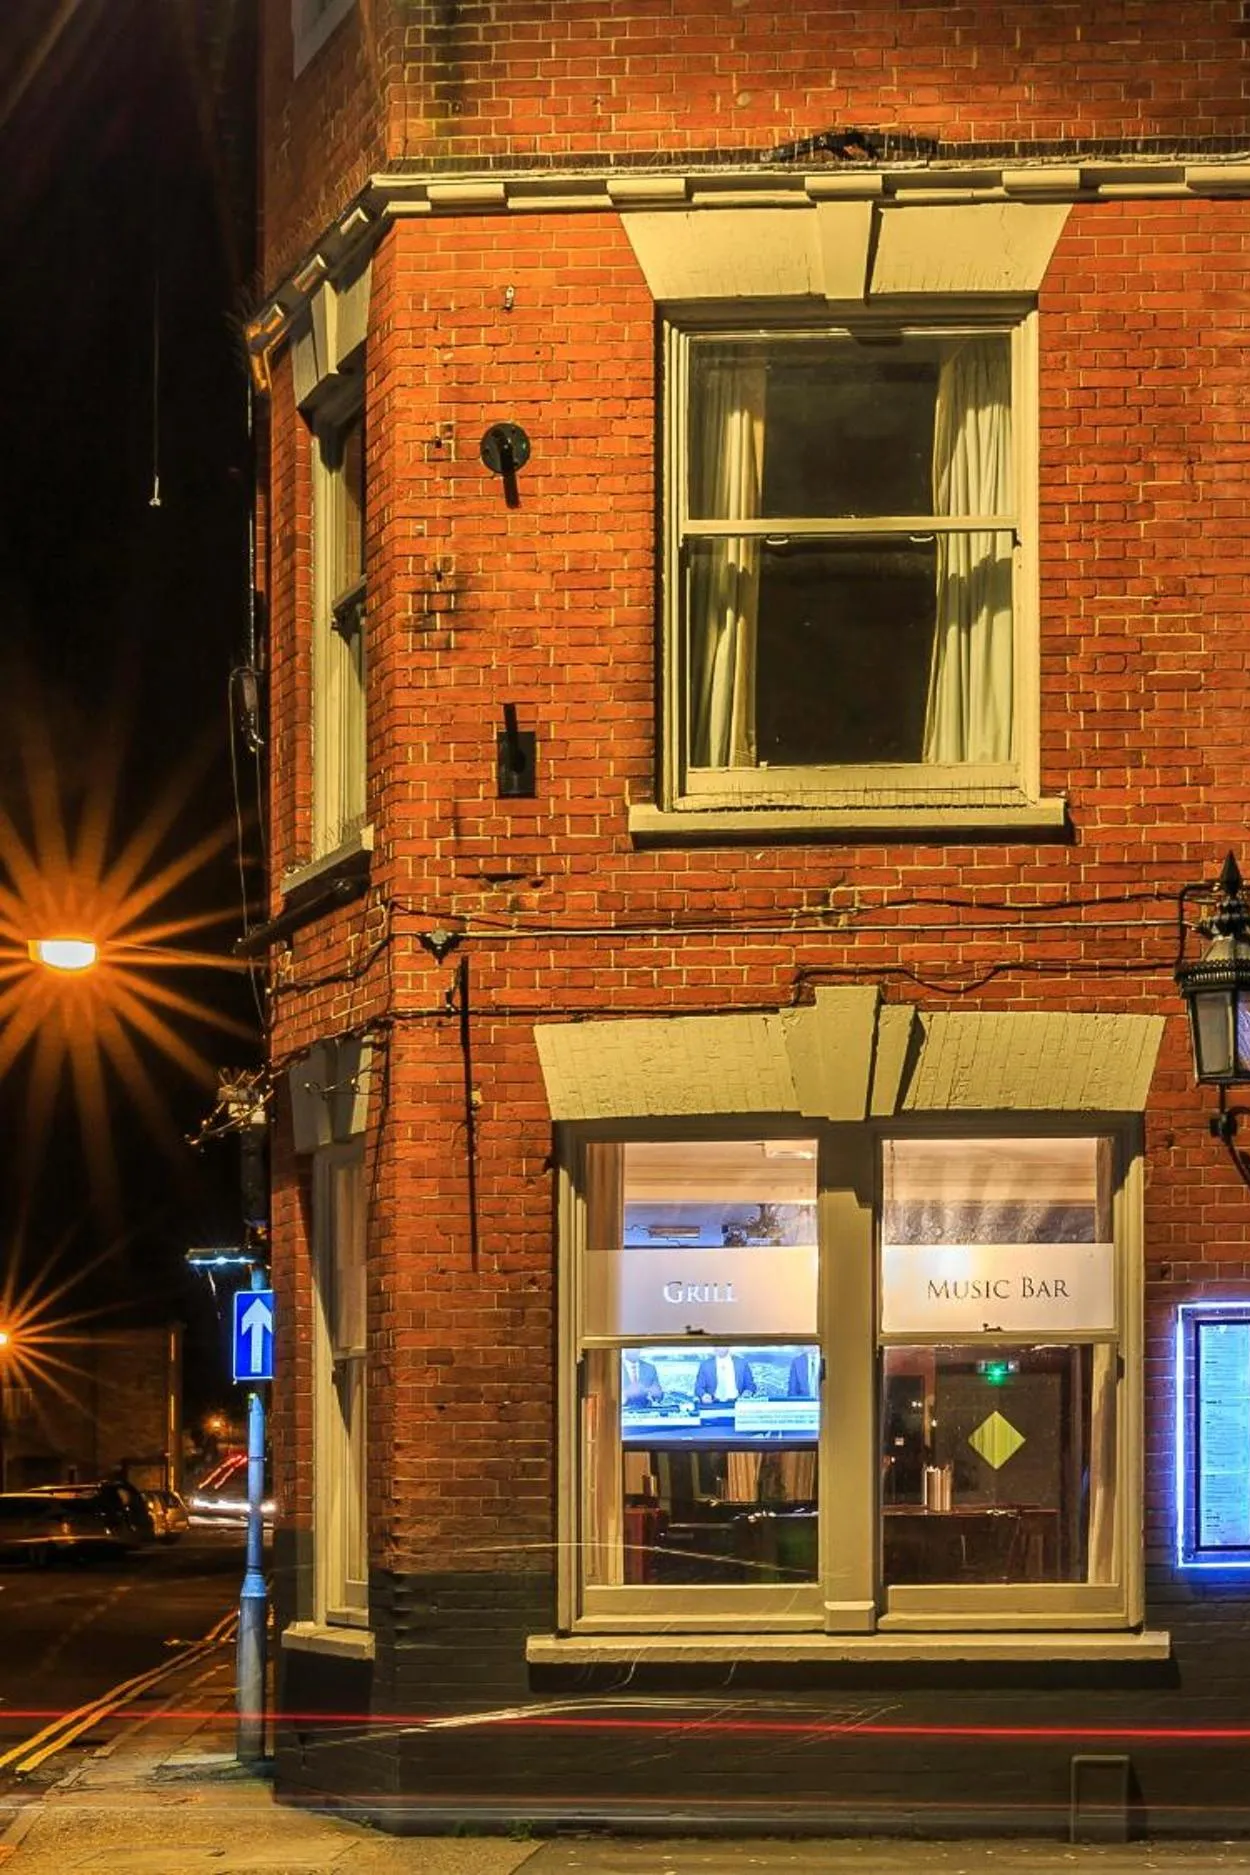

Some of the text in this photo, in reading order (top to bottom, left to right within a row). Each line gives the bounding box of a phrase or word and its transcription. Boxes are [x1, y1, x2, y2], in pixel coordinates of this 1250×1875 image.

[663, 1281, 738, 1303] GRILL
[927, 1276, 1070, 1299] MUSIC BAR
